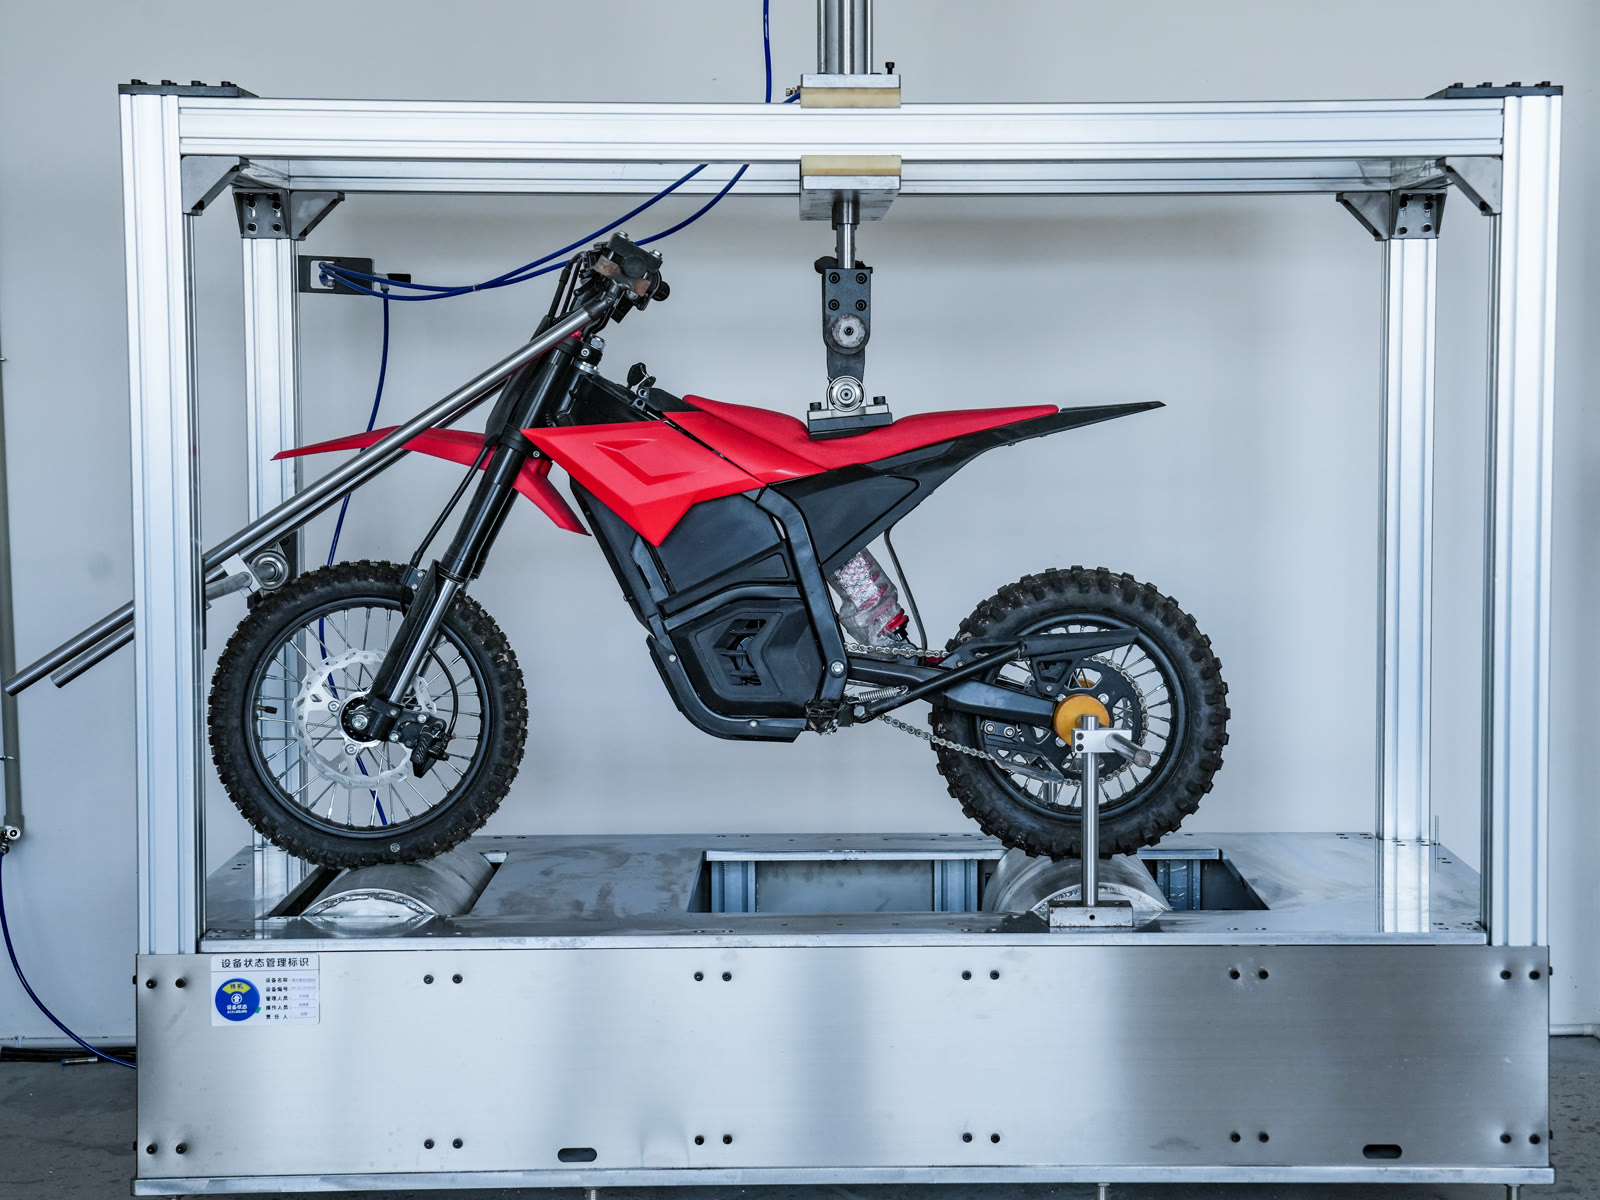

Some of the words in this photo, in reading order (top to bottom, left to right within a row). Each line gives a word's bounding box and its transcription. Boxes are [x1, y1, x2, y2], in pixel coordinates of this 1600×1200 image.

[221, 957, 310, 969] 设备状态管理标识
